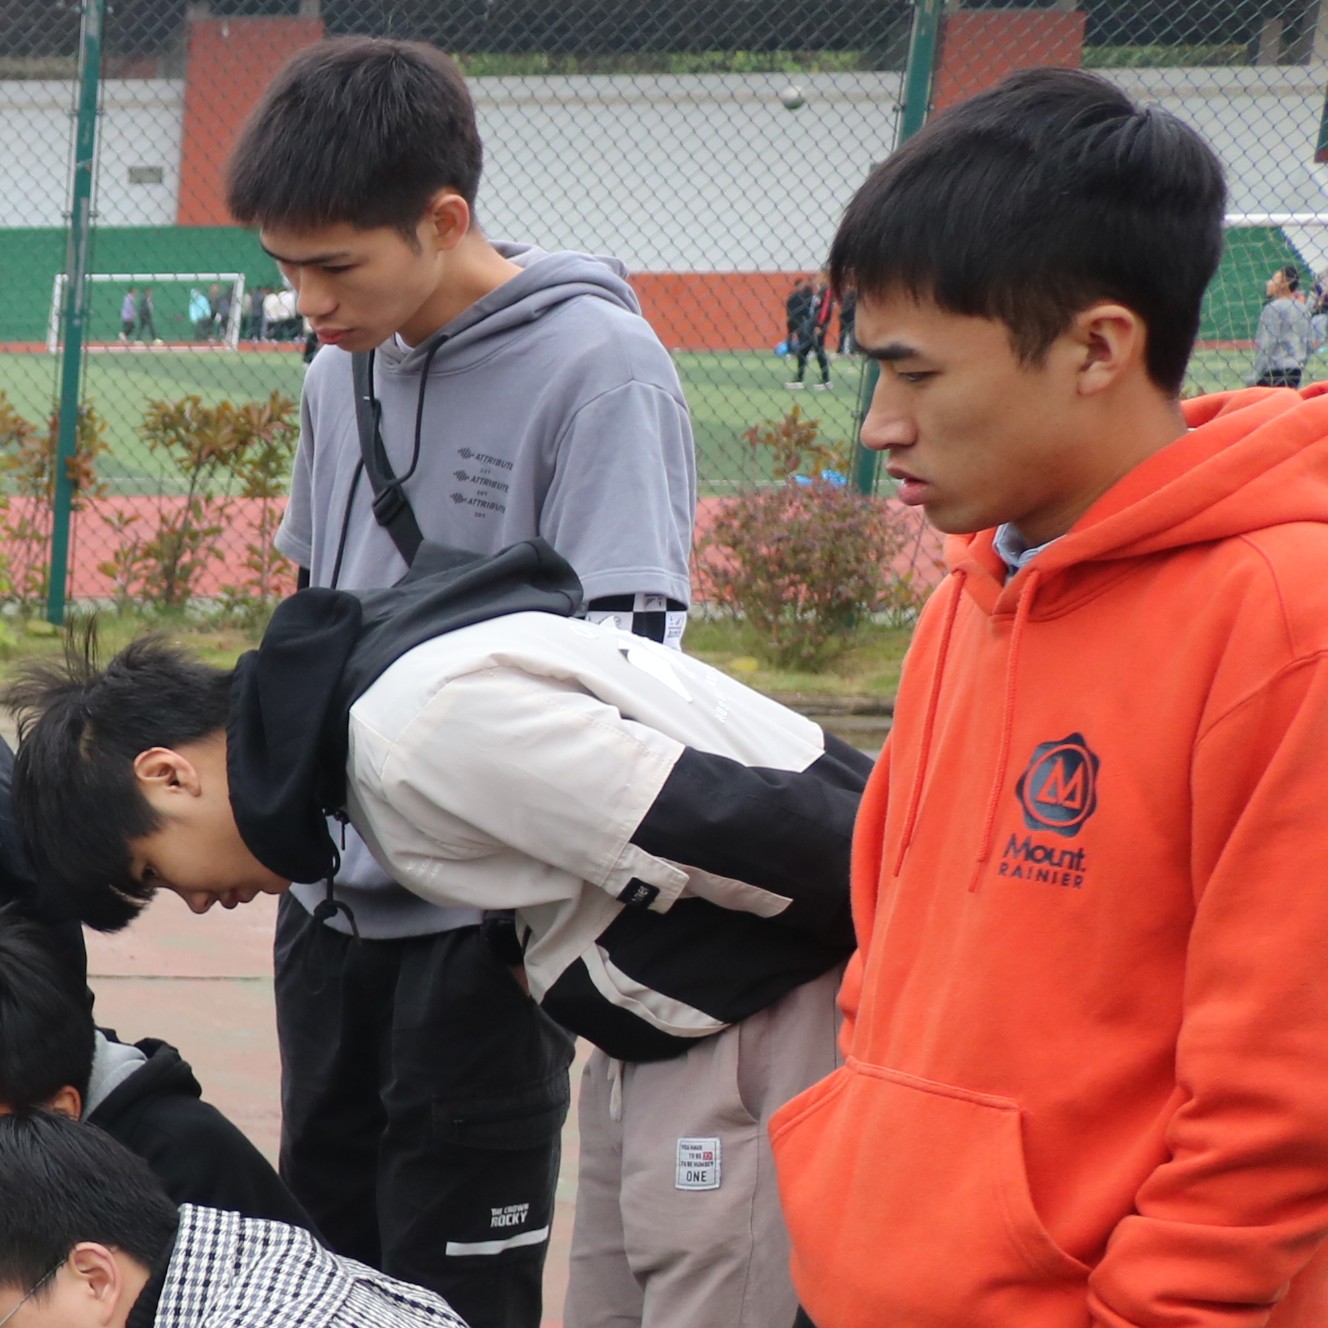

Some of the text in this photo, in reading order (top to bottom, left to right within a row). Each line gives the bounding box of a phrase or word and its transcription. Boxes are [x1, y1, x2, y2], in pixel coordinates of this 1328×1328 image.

[998, 862, 1084, 889] RAINIER
[686, 1170, 707, 1182] ONE
[490, 1211, 528, 1228] ROCKY
